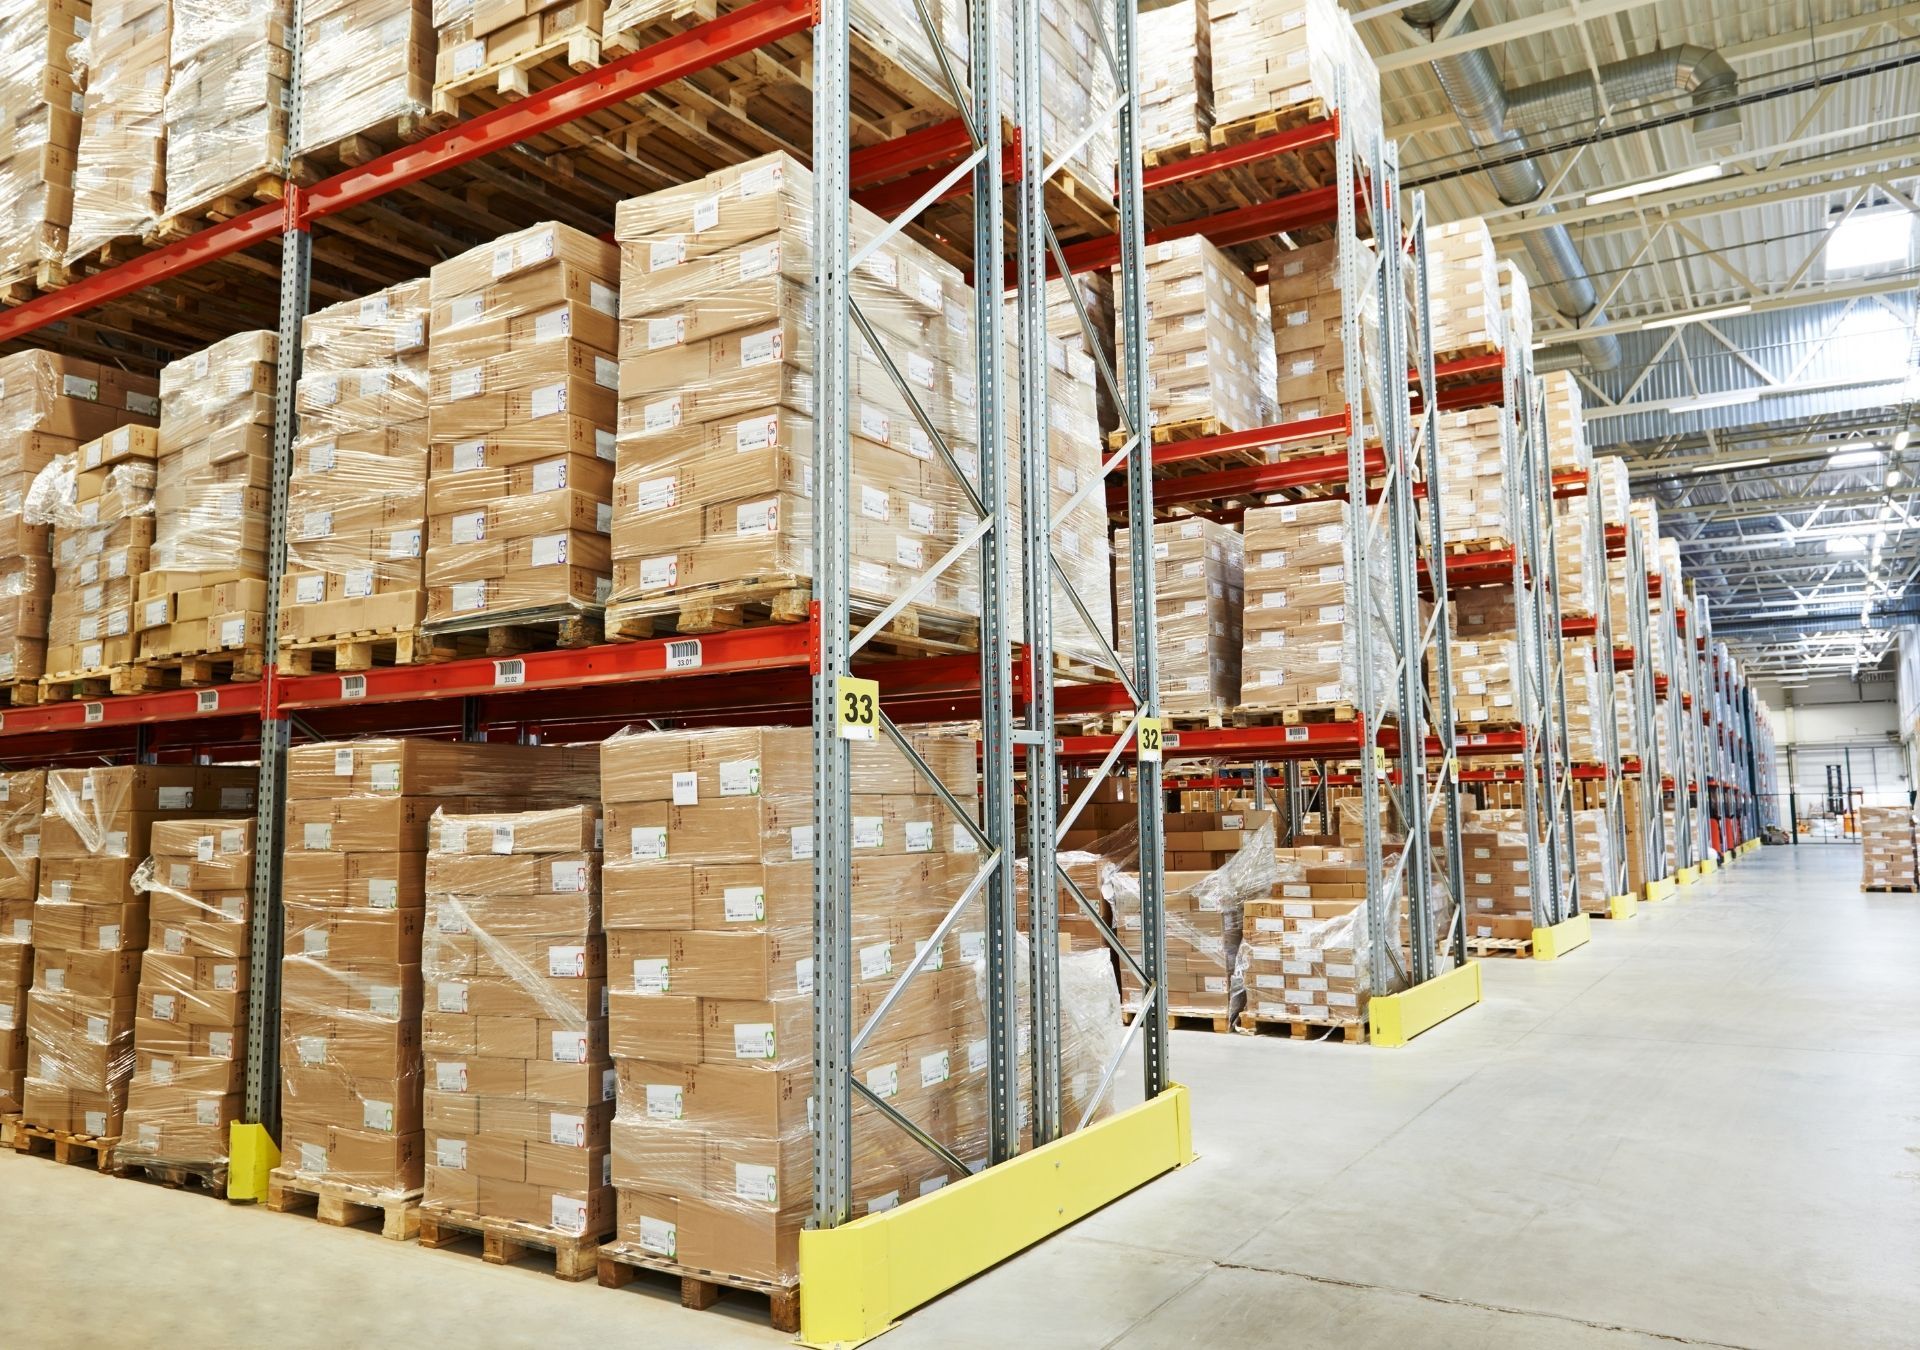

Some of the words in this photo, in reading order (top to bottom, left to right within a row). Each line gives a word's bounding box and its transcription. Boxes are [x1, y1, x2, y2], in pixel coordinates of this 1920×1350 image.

[677, 658, 692, 666] 33.01
[844, 692, 873, 724] 33
[1142, 728, 1158, 750] 32
[1376, 754, 1384, 768] 31
